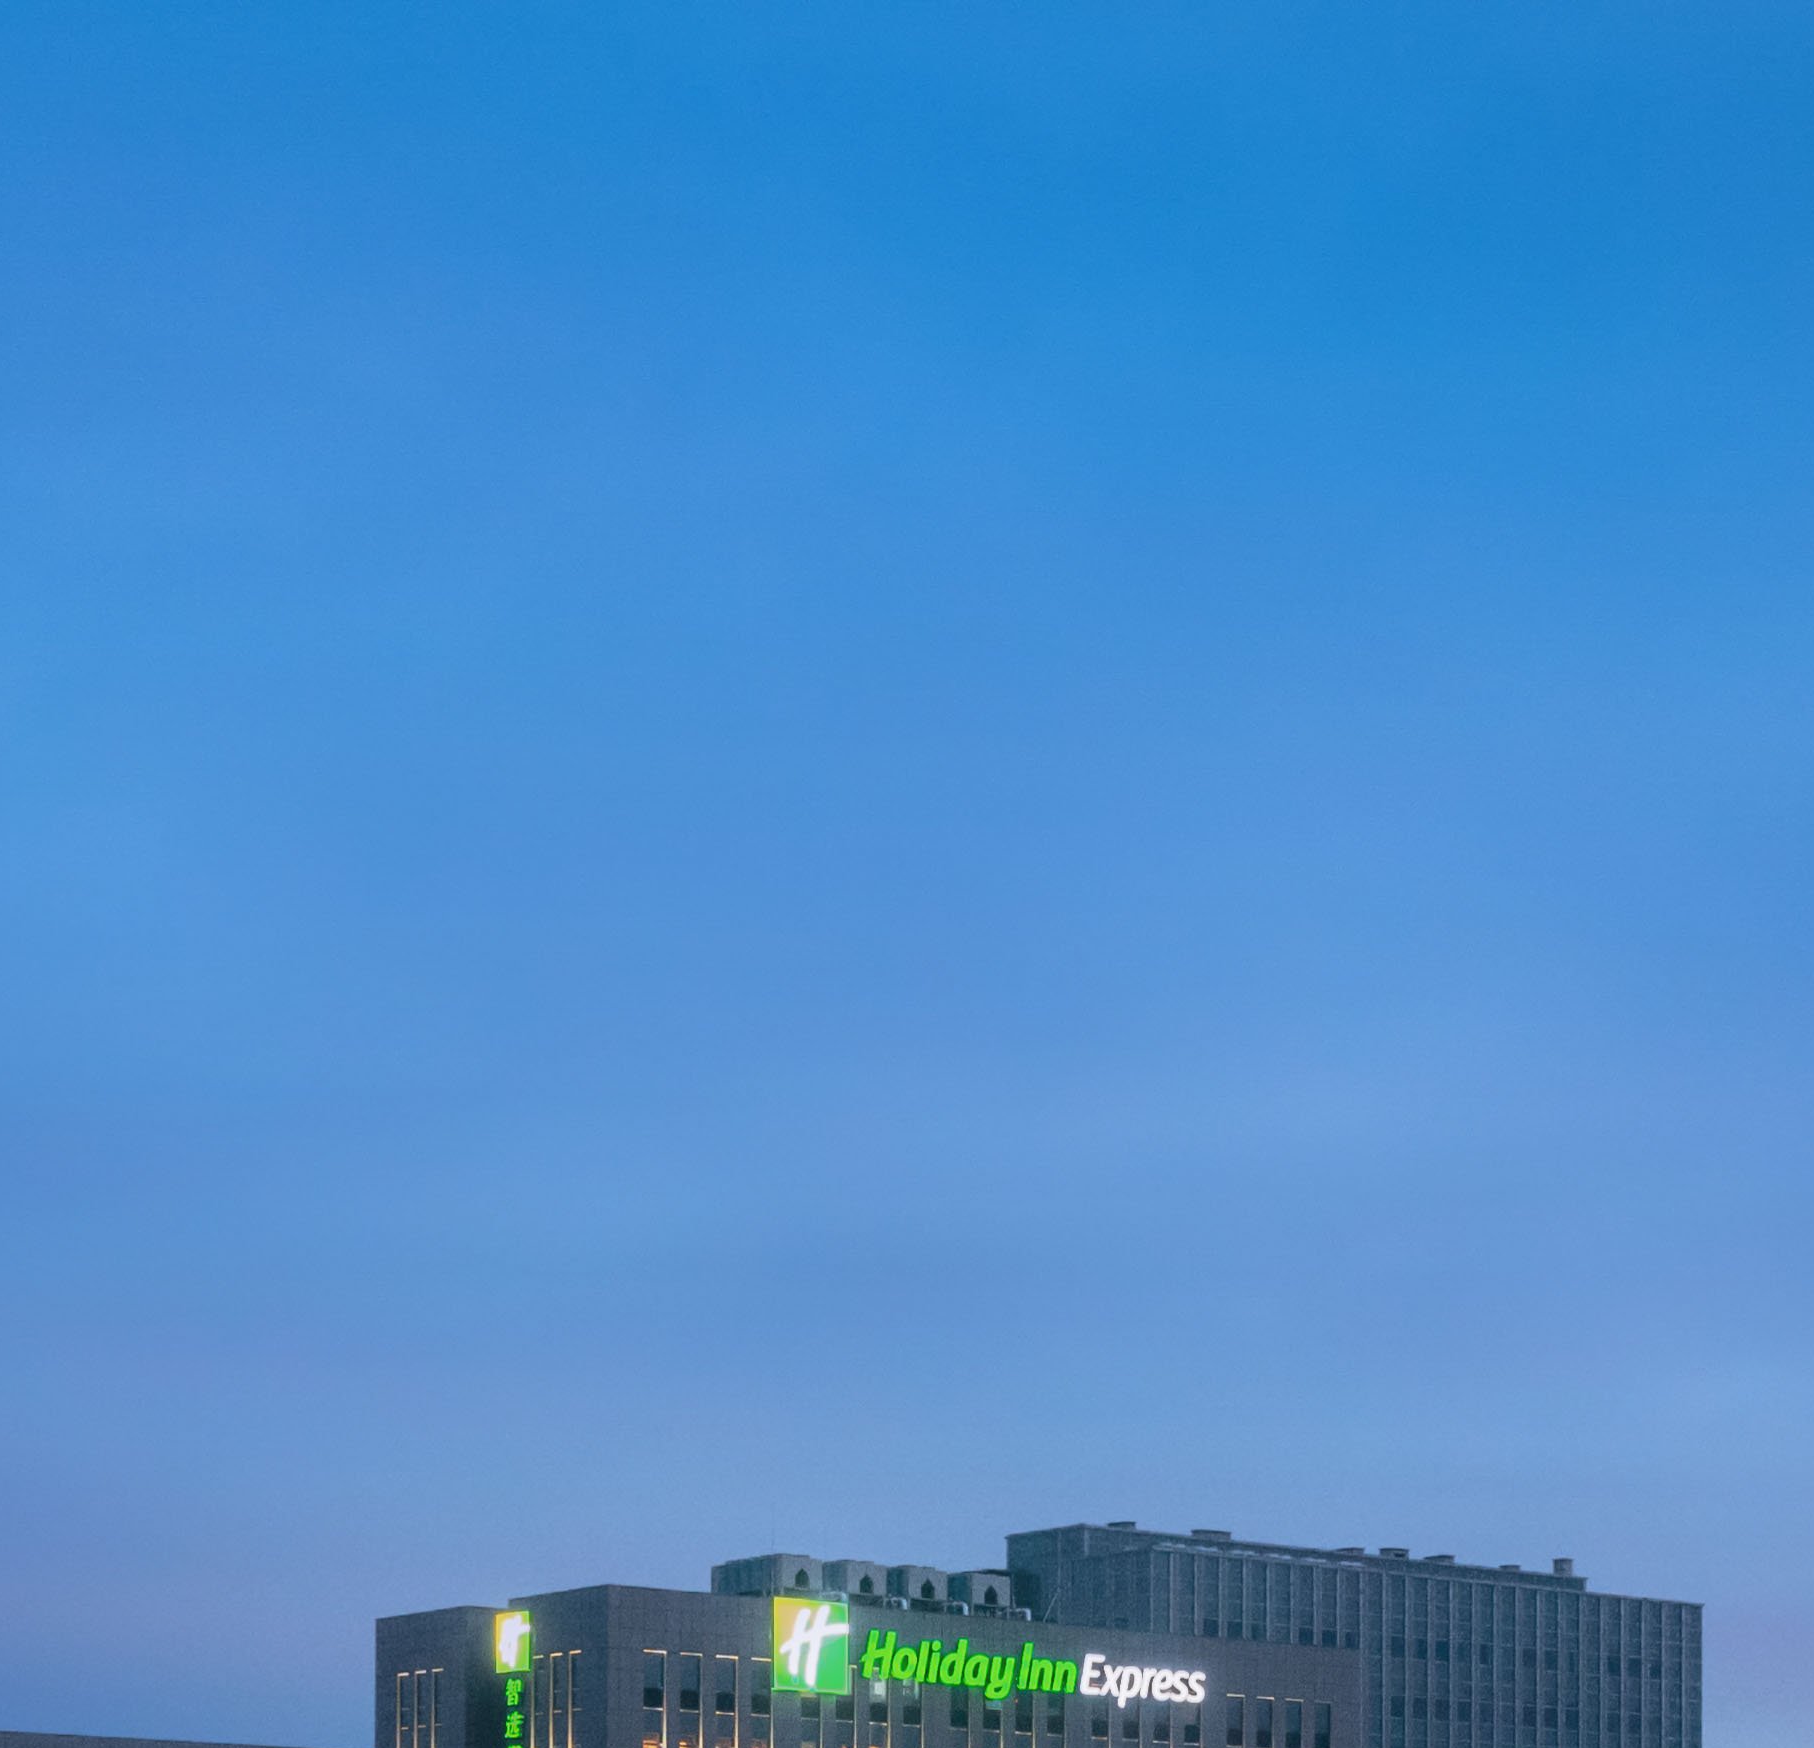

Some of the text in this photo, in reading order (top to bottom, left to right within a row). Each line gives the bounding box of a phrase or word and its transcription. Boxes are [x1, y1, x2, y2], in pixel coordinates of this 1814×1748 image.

[860, 1628, 1207, 1708] Holiday Inn Express
